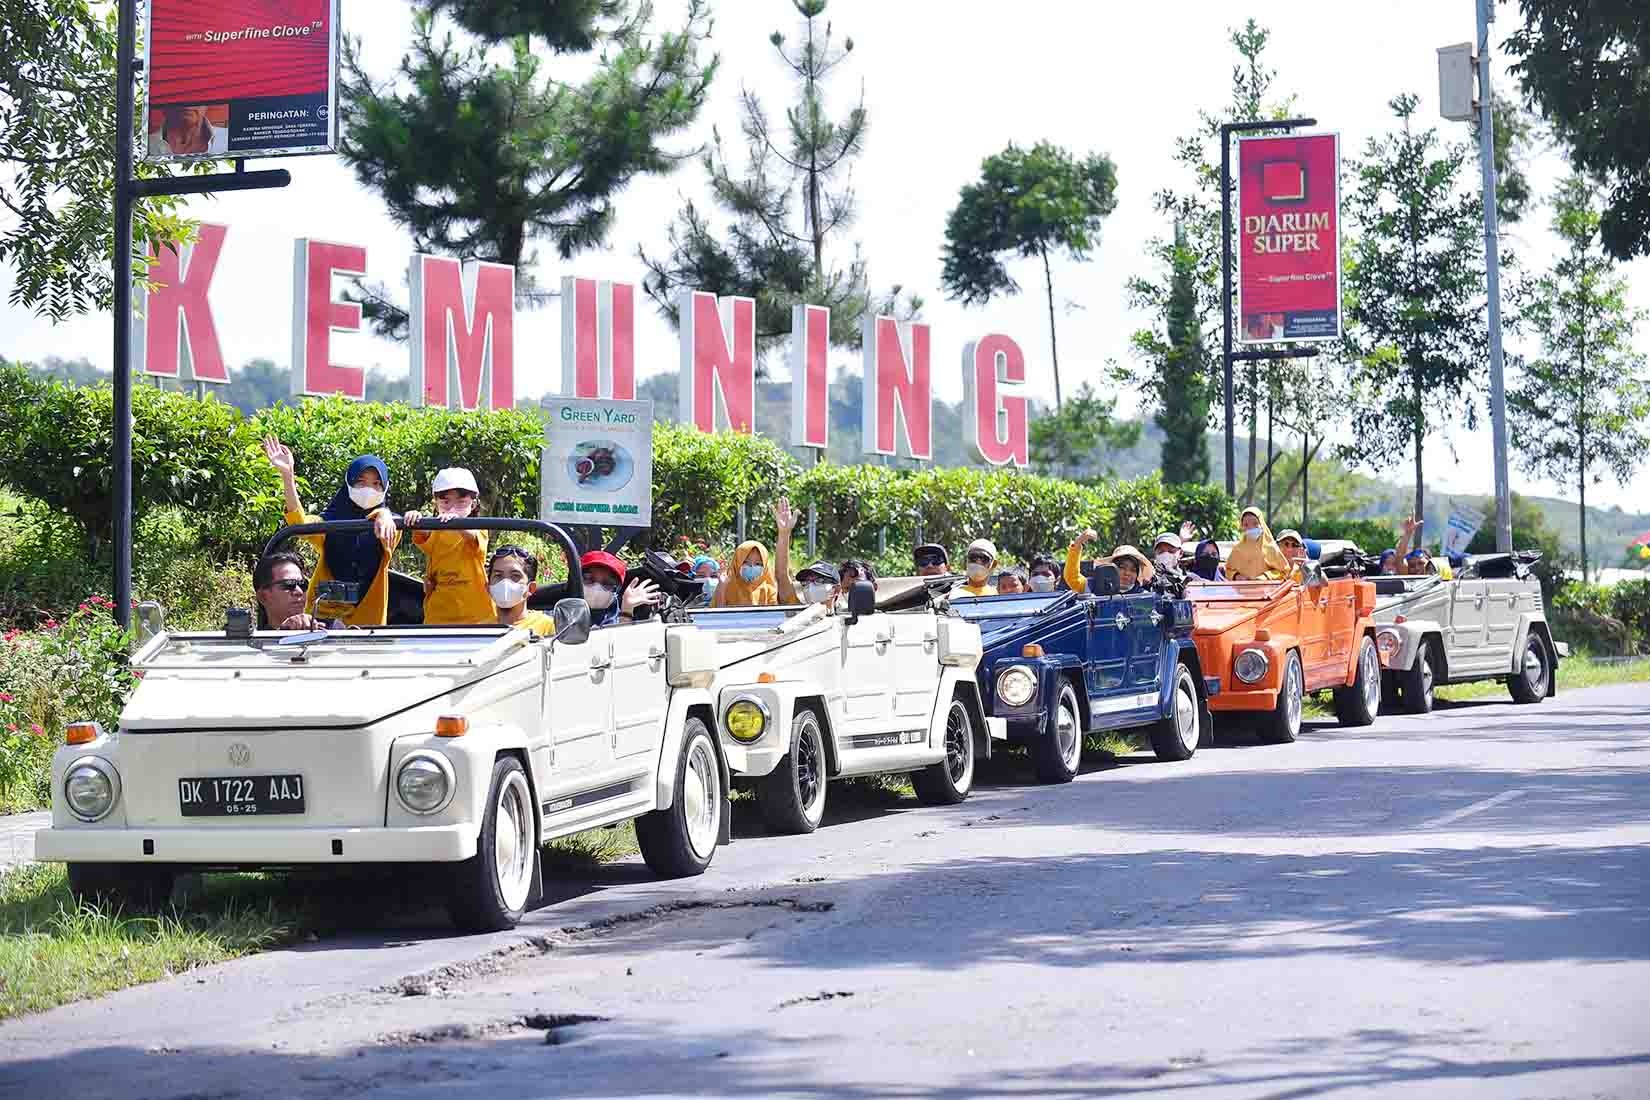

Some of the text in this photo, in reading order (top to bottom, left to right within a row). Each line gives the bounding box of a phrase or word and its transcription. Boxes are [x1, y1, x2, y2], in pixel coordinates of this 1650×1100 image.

[204, 27, 270, 44] Superfine
[248, 109, 310, 121] PERINGATAN:
[1244, 212, 1330, 235] DJARUM
[1252, 233, 1321, 254] SUPER
[142, 222, 1031, 468] KEMUNING
[180, 776, 302, 803] DK 1722 AAJ
